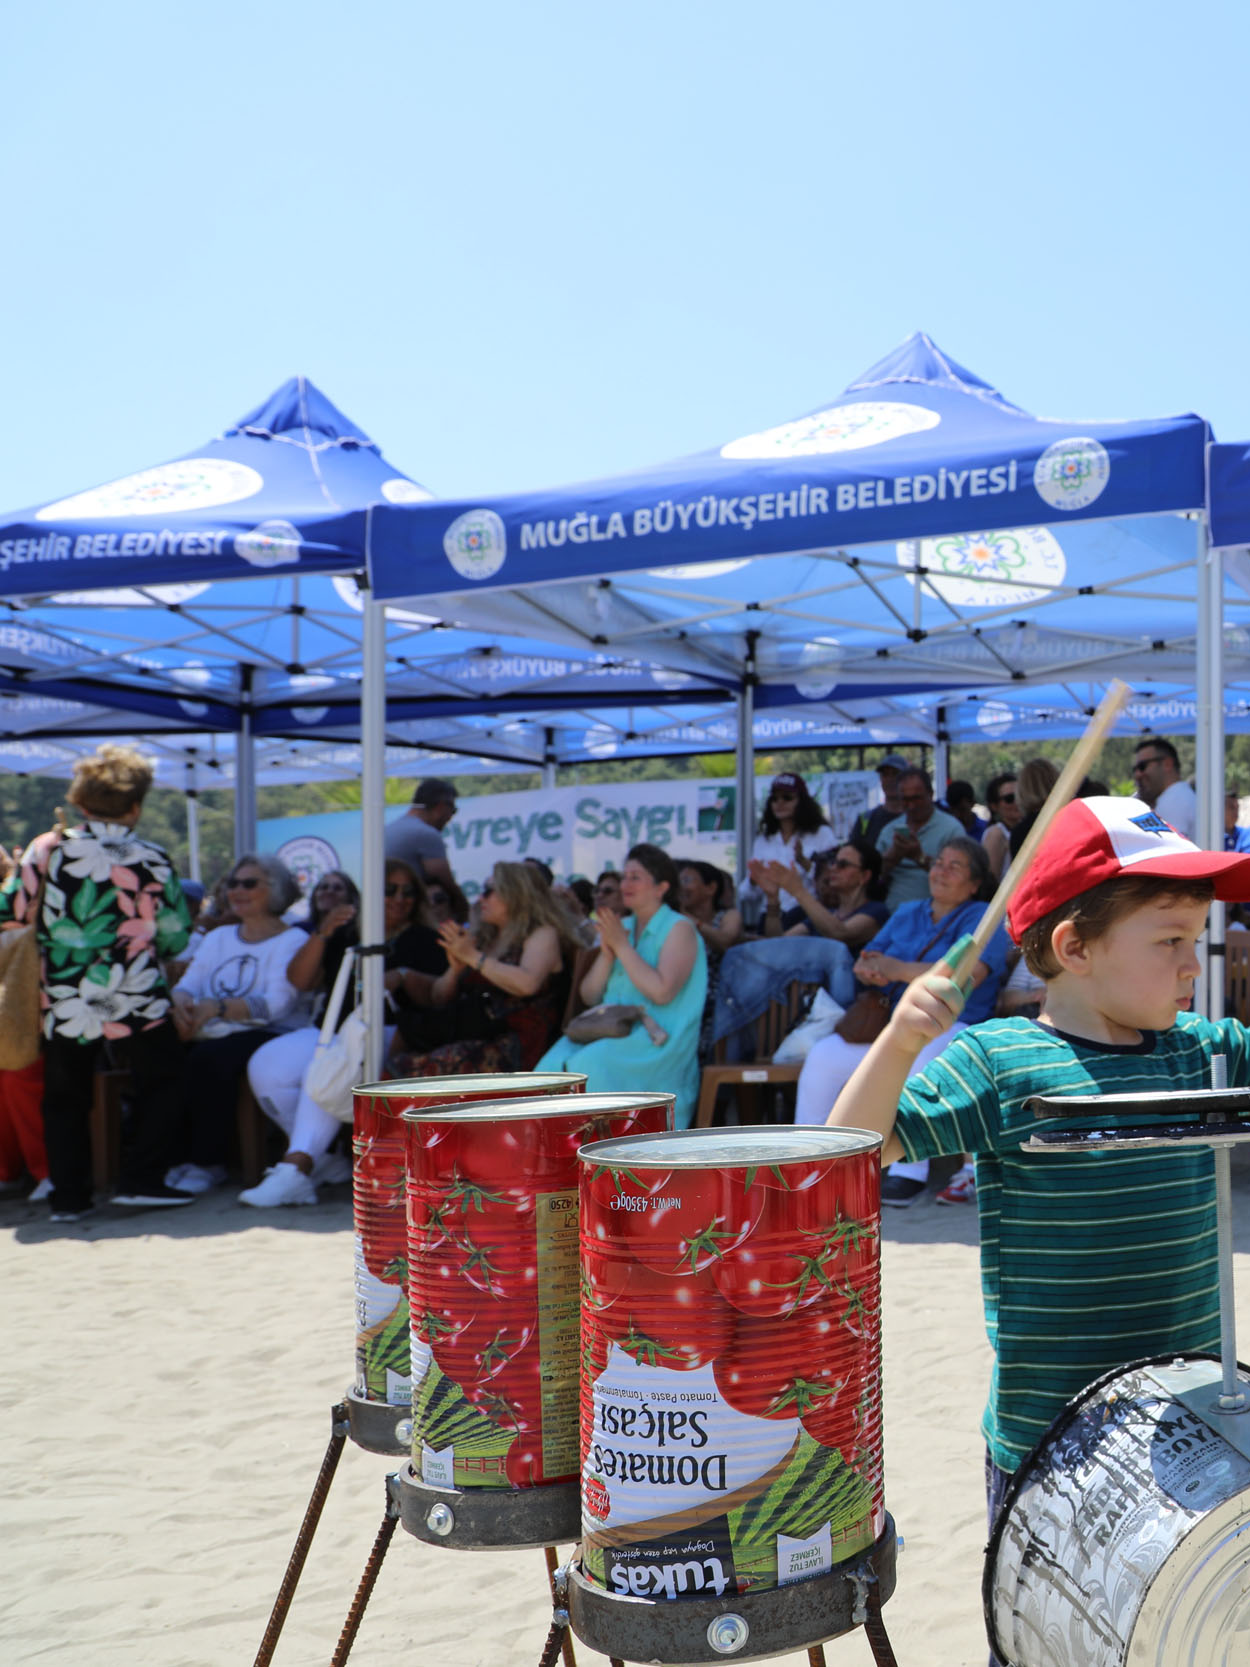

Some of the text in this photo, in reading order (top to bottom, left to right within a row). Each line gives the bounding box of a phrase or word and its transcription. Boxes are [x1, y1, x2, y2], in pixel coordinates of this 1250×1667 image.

[520, 511, 628, 550] MUĞLA
[633, 483, 829, 536] BÜYÜKŞEHİR
[836, 459, 1018, 513] BELEDİYESİ
[575, 798, 694, 847] Saygı,
[551, 1199, 573, 1210] 4250
[651, 1391, 677, 1404] Paste
[680, 1392, 718, 1403] Tomato
[601, 1402, 709, 1449] Salçası
[593, 1444, 728, 1491] Domates
[643, 1548, 661, 1559] özen
[661, 1546, 678, 1558] hep
[790, 1546, 821, 1562] İÇERMEZ
[788, 1556, 824, 1574] İLAVE TUZ
[610, 1557, 731, 1600] tukaş
